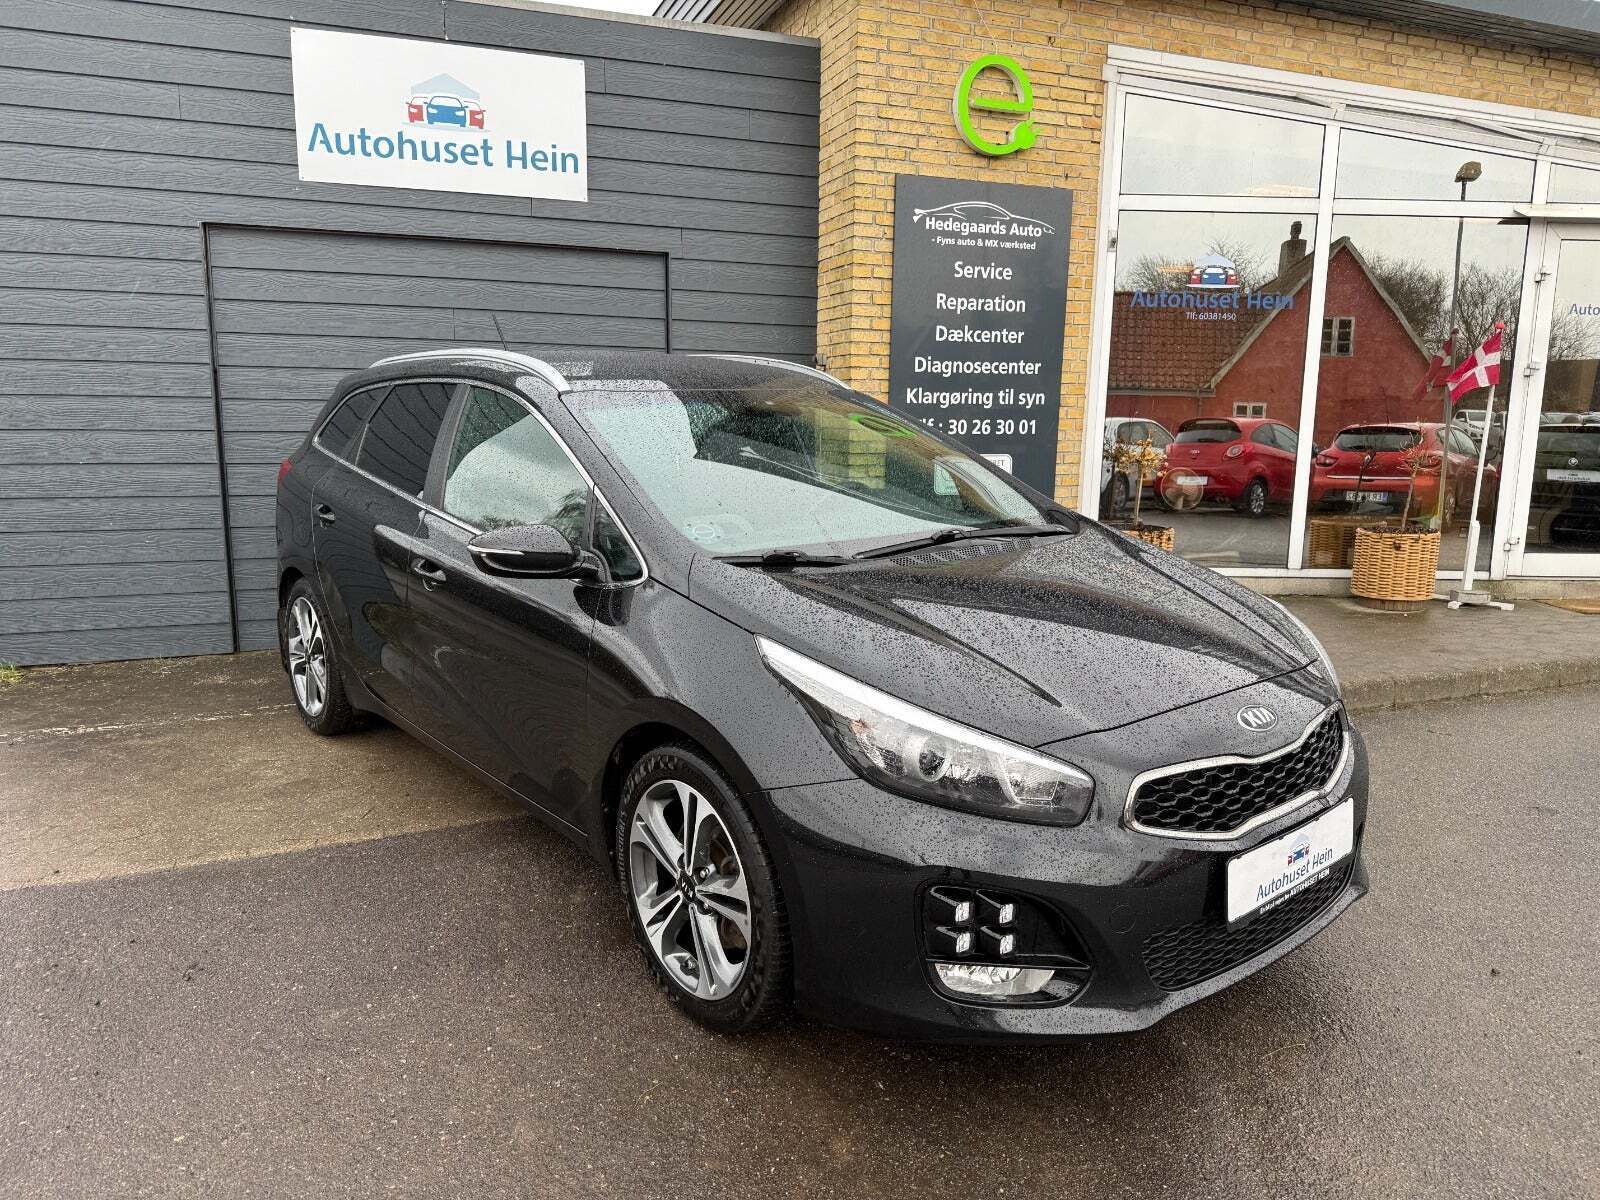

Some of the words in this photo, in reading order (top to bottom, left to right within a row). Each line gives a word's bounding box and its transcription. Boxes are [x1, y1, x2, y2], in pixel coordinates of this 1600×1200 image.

[307, 122, 493, 167] Autohuset
[506, 140, 580, 173] Hein
[925, 217, 1006, 235] Hedegaards
[1010, 223, 1042, 237] Auto
[936, 236, 956, 245] Fyns
[977, 239, 983, 247] &
[985, 239, 998, 247] MX
[1000, 241, 1036, 250] værksted
[954, 261, 1013, 280] Service
[936, 293, 1026, 314] Reparation
[1130, 287, 1240, 309] Autohuset
[1247, 289, 1295, 310] Hein
[935, 325, 1025, 344] Dækcenter
[914, 356, 1042, 377] Diagnosecenter
[906, 387, 993, 408] Klargøring
[998, 388, 1014, 405] til
[1018, 392, 1045, 408] syn
[948, 419, 968, 435] 30
[971, 419, 991, 435] 26
[995, 419, 1015, 435] 30
[1018, 419, 1037, 435] 01
[1242, 706, 1276, 727] KIA
[1256, 861, 1310, 902] Autohuset
[1312, 847, 1333, 870] Hein
